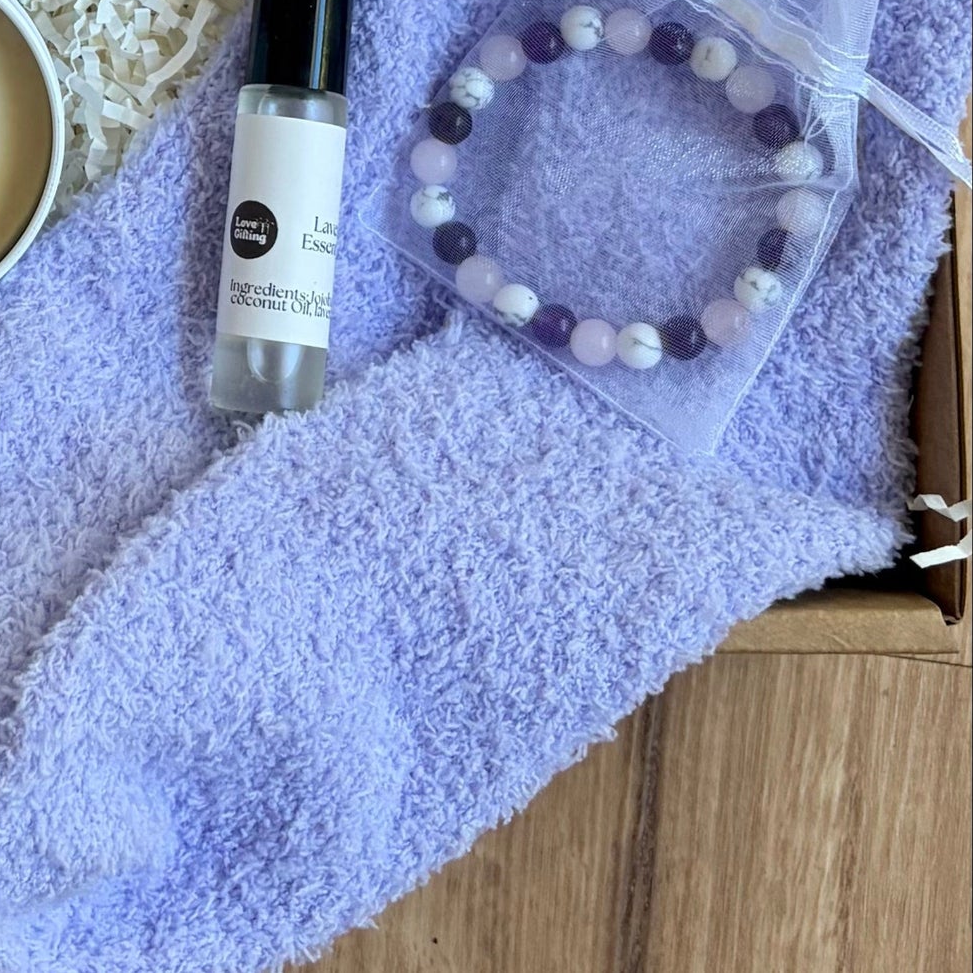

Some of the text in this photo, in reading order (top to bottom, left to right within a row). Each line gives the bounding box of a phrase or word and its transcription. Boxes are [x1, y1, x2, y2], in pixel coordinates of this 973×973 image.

[235, 216, 257, 229] Love
[234, 228, 267, 245] Gifting
[230, 293, 287, 312] coconut
